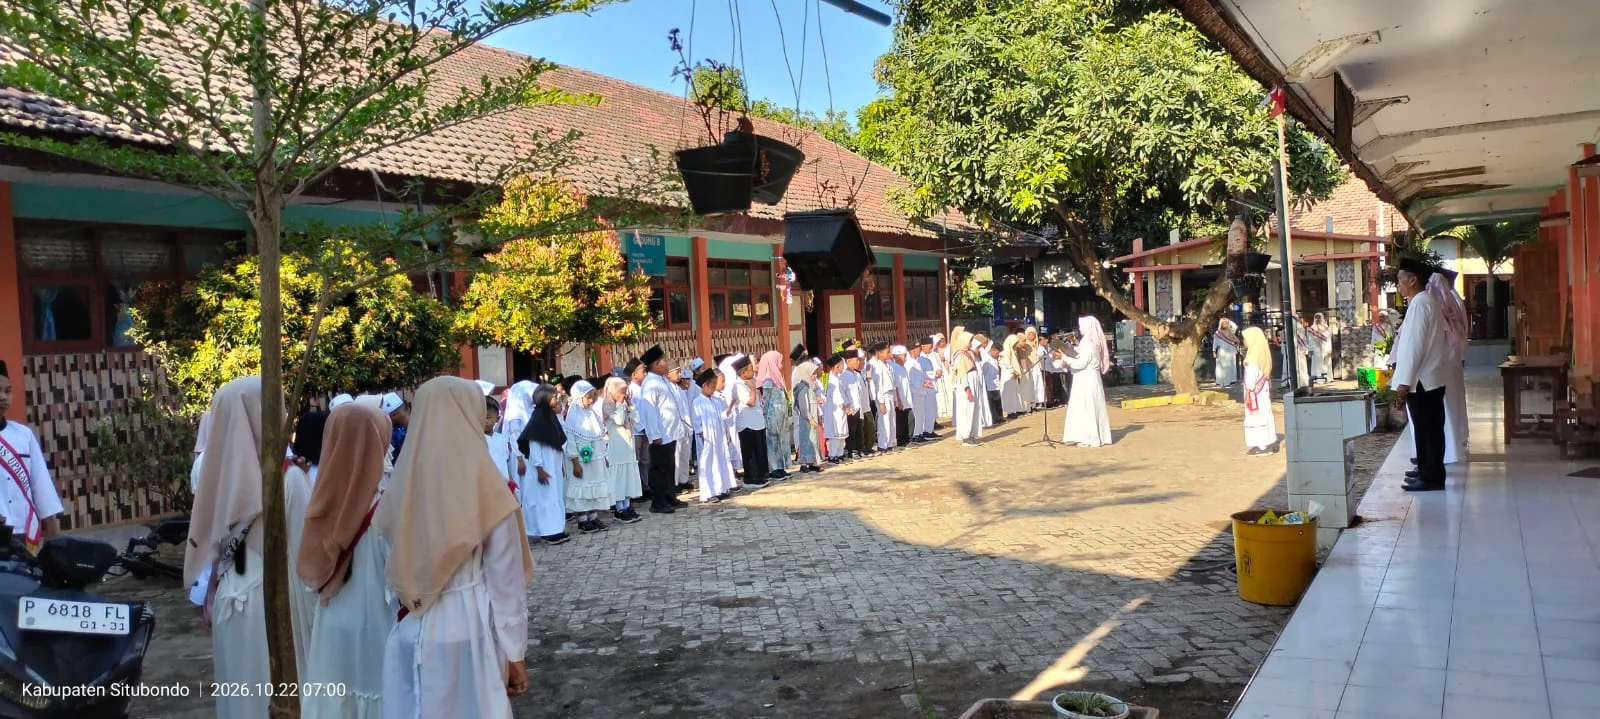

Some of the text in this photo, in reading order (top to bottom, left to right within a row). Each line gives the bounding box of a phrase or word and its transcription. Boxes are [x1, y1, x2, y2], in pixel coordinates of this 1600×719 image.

[633, 236, 656, 246] GDUNG
[25, 600, 125, 620] P 6818 FL
